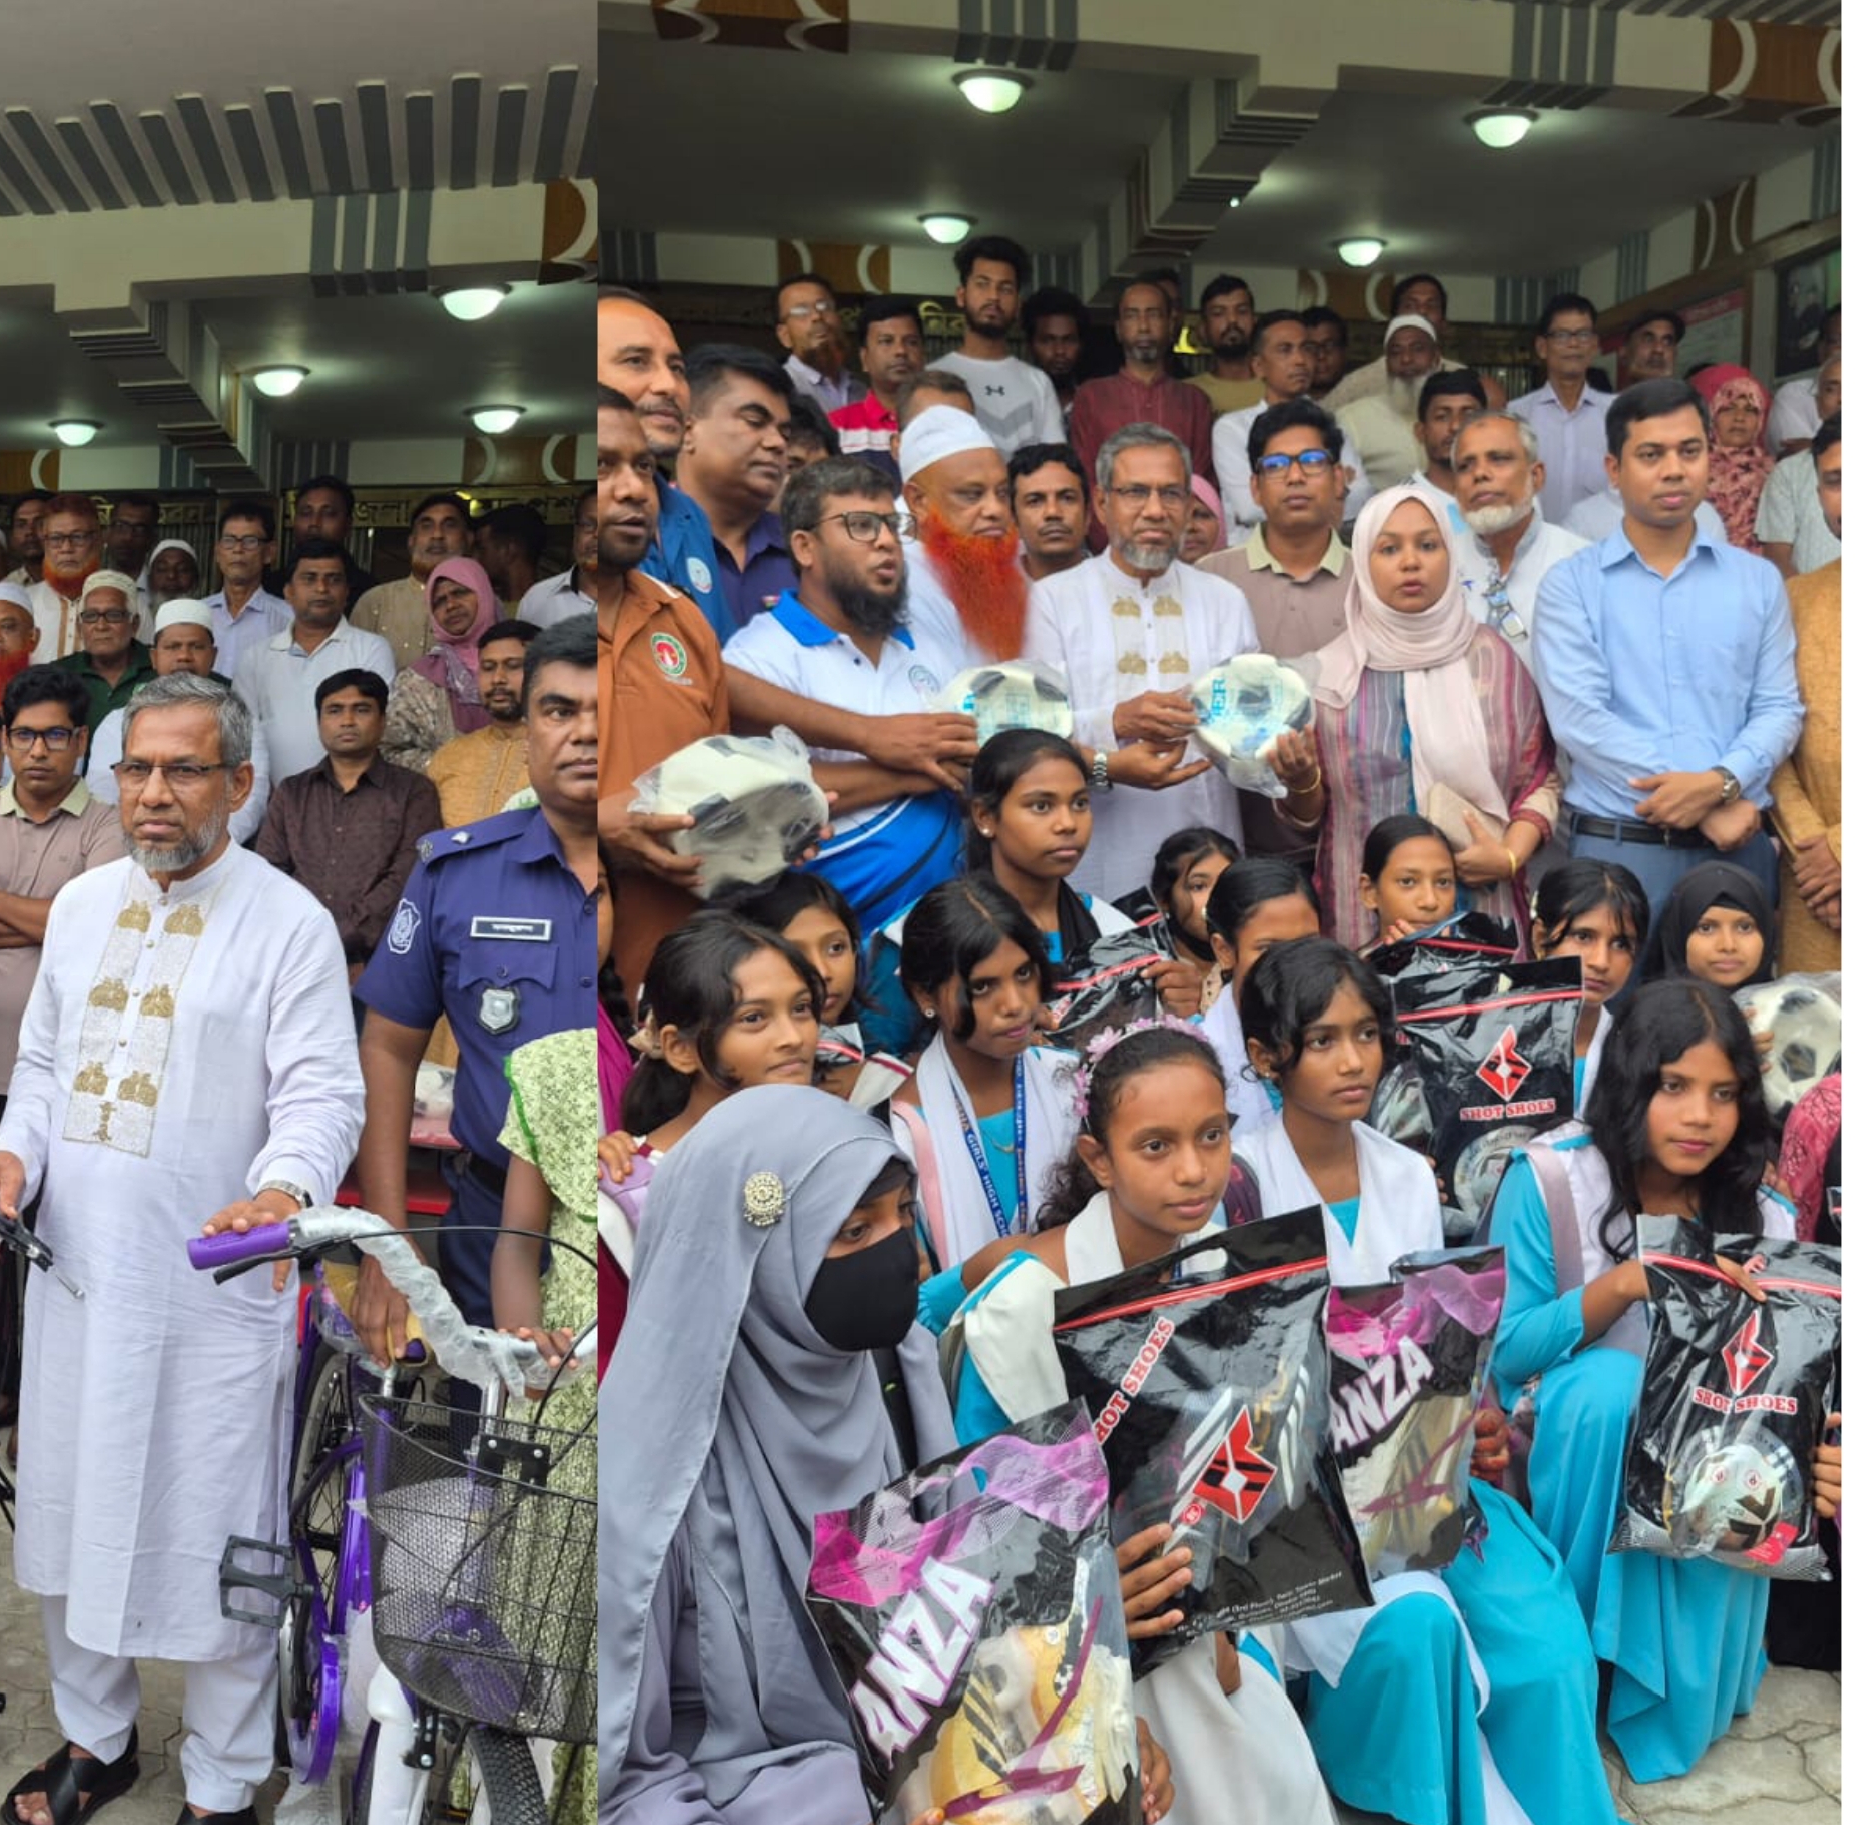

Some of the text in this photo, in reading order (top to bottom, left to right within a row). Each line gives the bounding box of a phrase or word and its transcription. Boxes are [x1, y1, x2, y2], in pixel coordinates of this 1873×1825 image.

[1460, 1098, 1556, 1121] SHOT SHOES
[1092, 1317, 1176, 1446] HOT SHOES
[1693, 1387, 1798, 1415] SHOT SHOES
